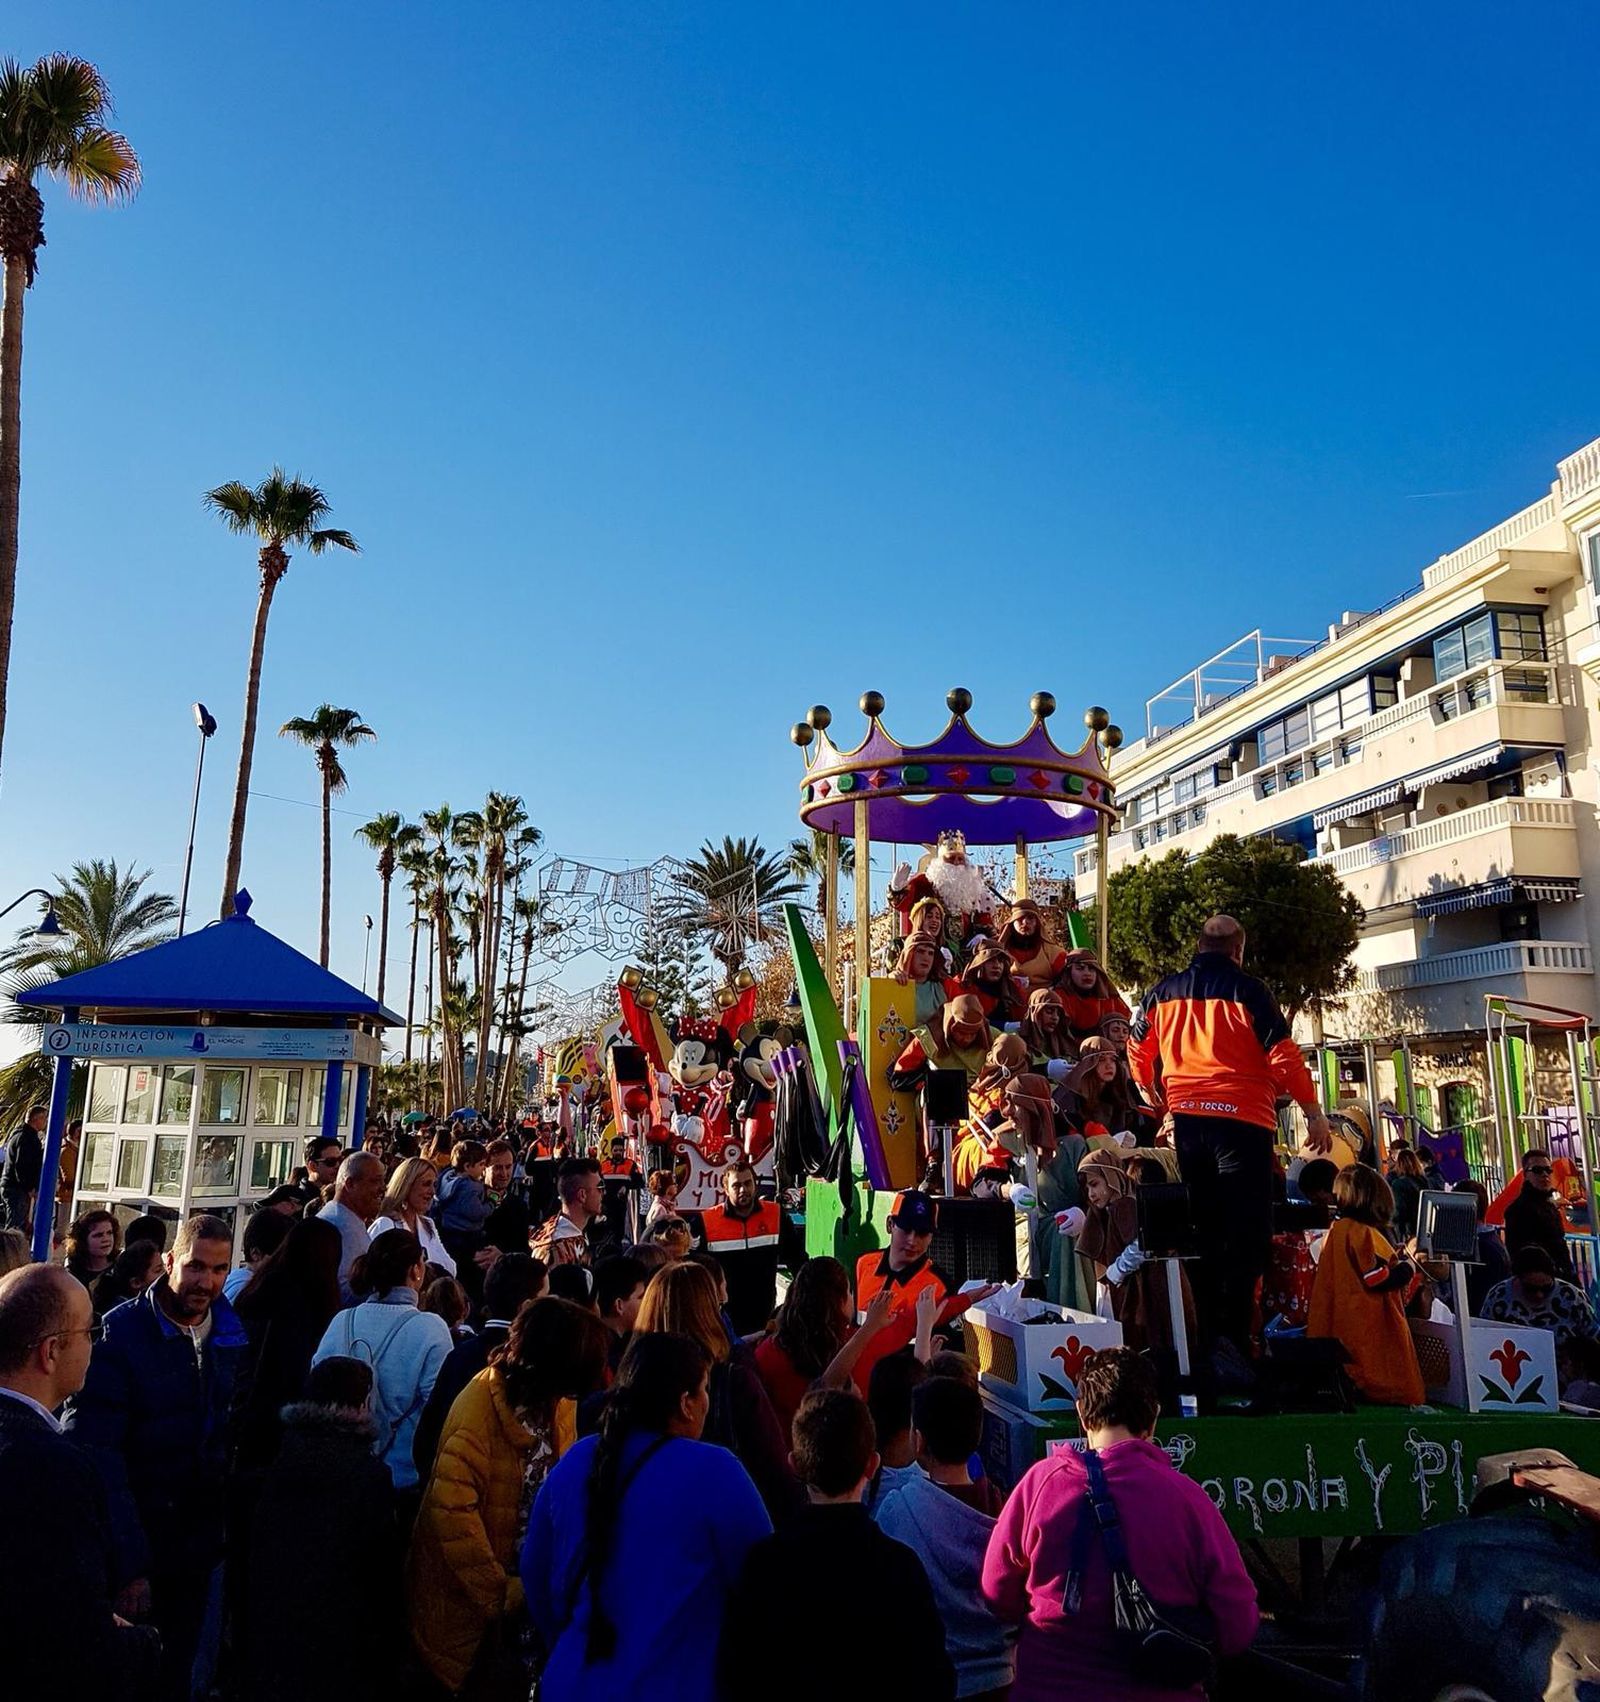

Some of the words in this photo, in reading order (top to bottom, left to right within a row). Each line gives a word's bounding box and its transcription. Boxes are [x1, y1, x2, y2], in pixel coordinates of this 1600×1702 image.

[75, 1040, 144, 1053] TURÍSTICA
[1432, 1050, 1473, 1069] SNACK
[1200, 1101, 1239, 1114] TORROX
[1354, 1438, 1392, 1530] Y
